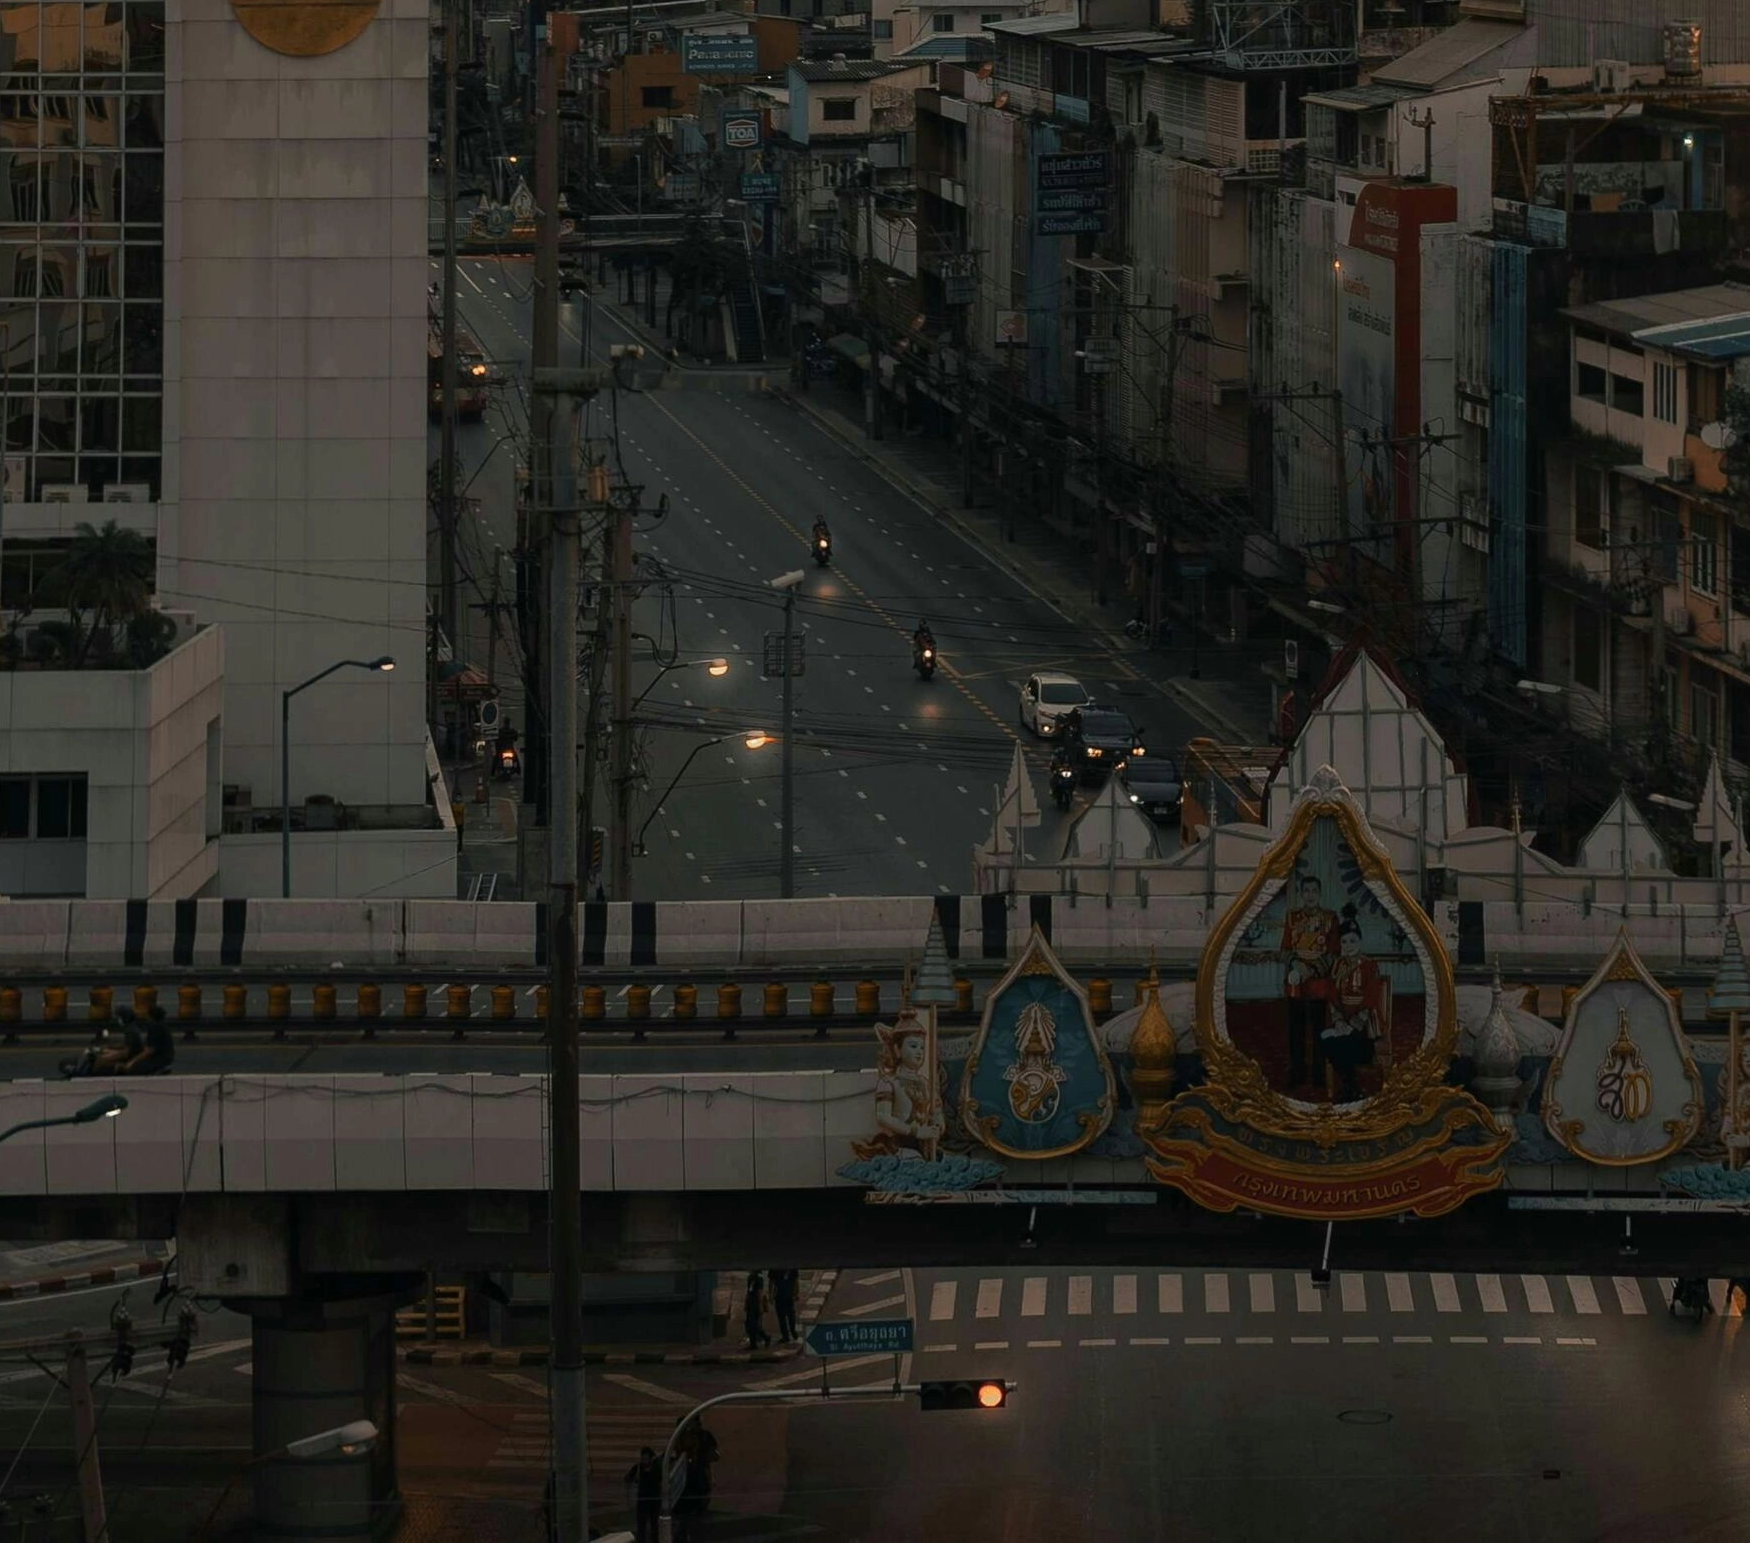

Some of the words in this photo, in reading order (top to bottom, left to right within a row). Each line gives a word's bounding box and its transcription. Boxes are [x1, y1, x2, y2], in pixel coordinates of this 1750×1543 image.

[728, 127, 755, 139] TOA
[1233, 1174, 1420, 1205] กรุงเทพมหานคร
